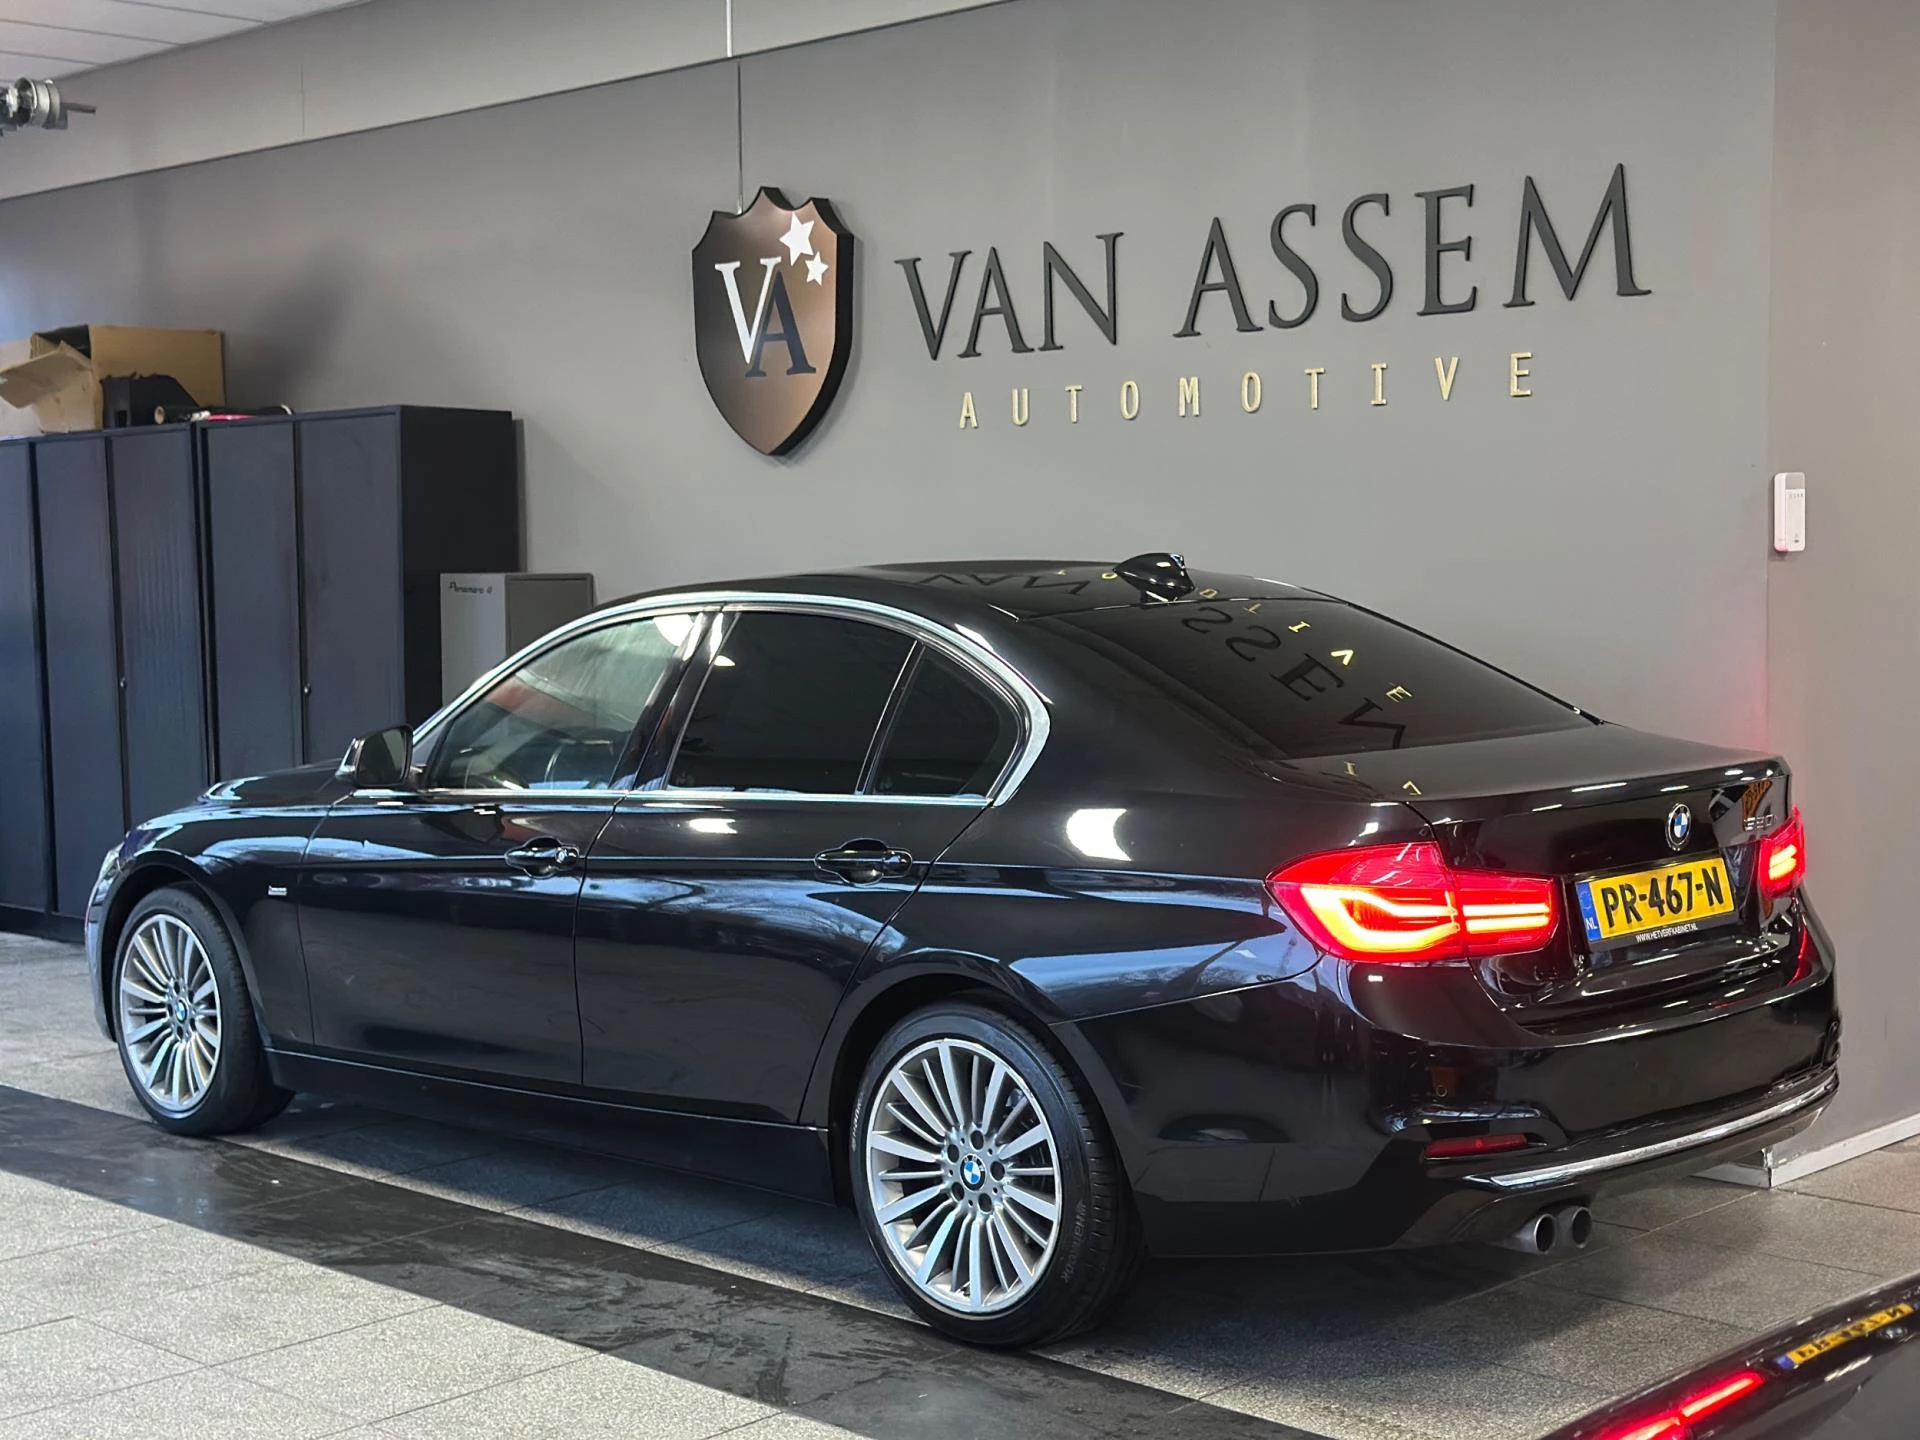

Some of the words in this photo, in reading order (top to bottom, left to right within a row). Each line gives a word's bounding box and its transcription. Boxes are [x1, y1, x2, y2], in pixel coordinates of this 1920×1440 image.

[894, 231, 1125, 361] VAN
[1172, 163, 1652, 338] ASSEM
[714, 256, 817, 378] VA
[957, 351, 1534, 429] AUTOMOTIVE
[1601, 865, 1725, 928] PR-467-N
